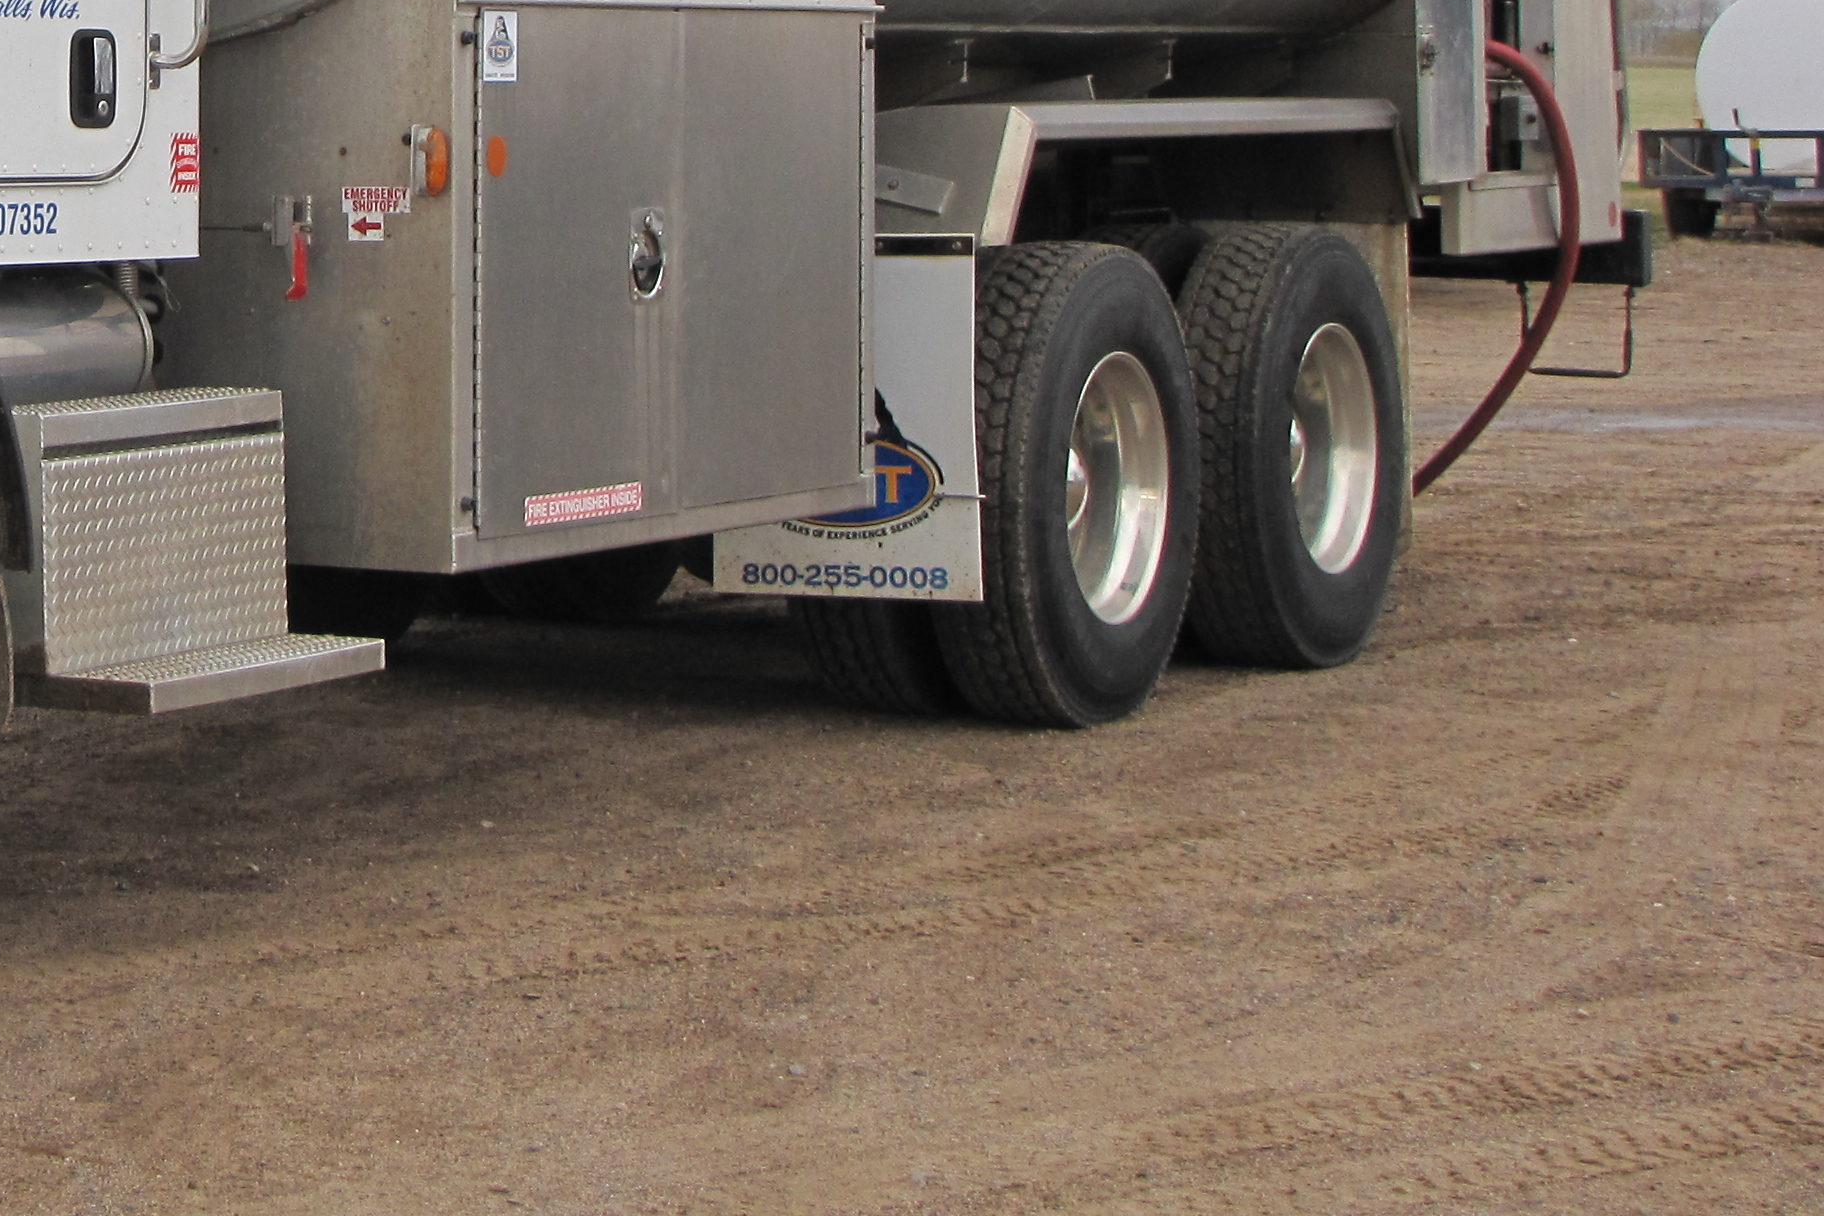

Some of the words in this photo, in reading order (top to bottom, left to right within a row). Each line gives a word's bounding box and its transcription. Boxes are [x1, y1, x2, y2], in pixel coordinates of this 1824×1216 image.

[489, 45, 511, 58] TST
[344, 187, 408, 200] EMERGENCY
[352, 200, 399, 212] SHUTOFF
[528, 503, 548, 518] FIRE
[549, 494, 610, 516] EXTINGUISHER
[611, 489, 637, 507] INSIDE
[813, 528, 826, 539] OF
[827, 527, 887, 540] EXPERIENCE
[890, 510, 929, 534] SERVING
[742, 562, 949, 590] 800-255-0008
